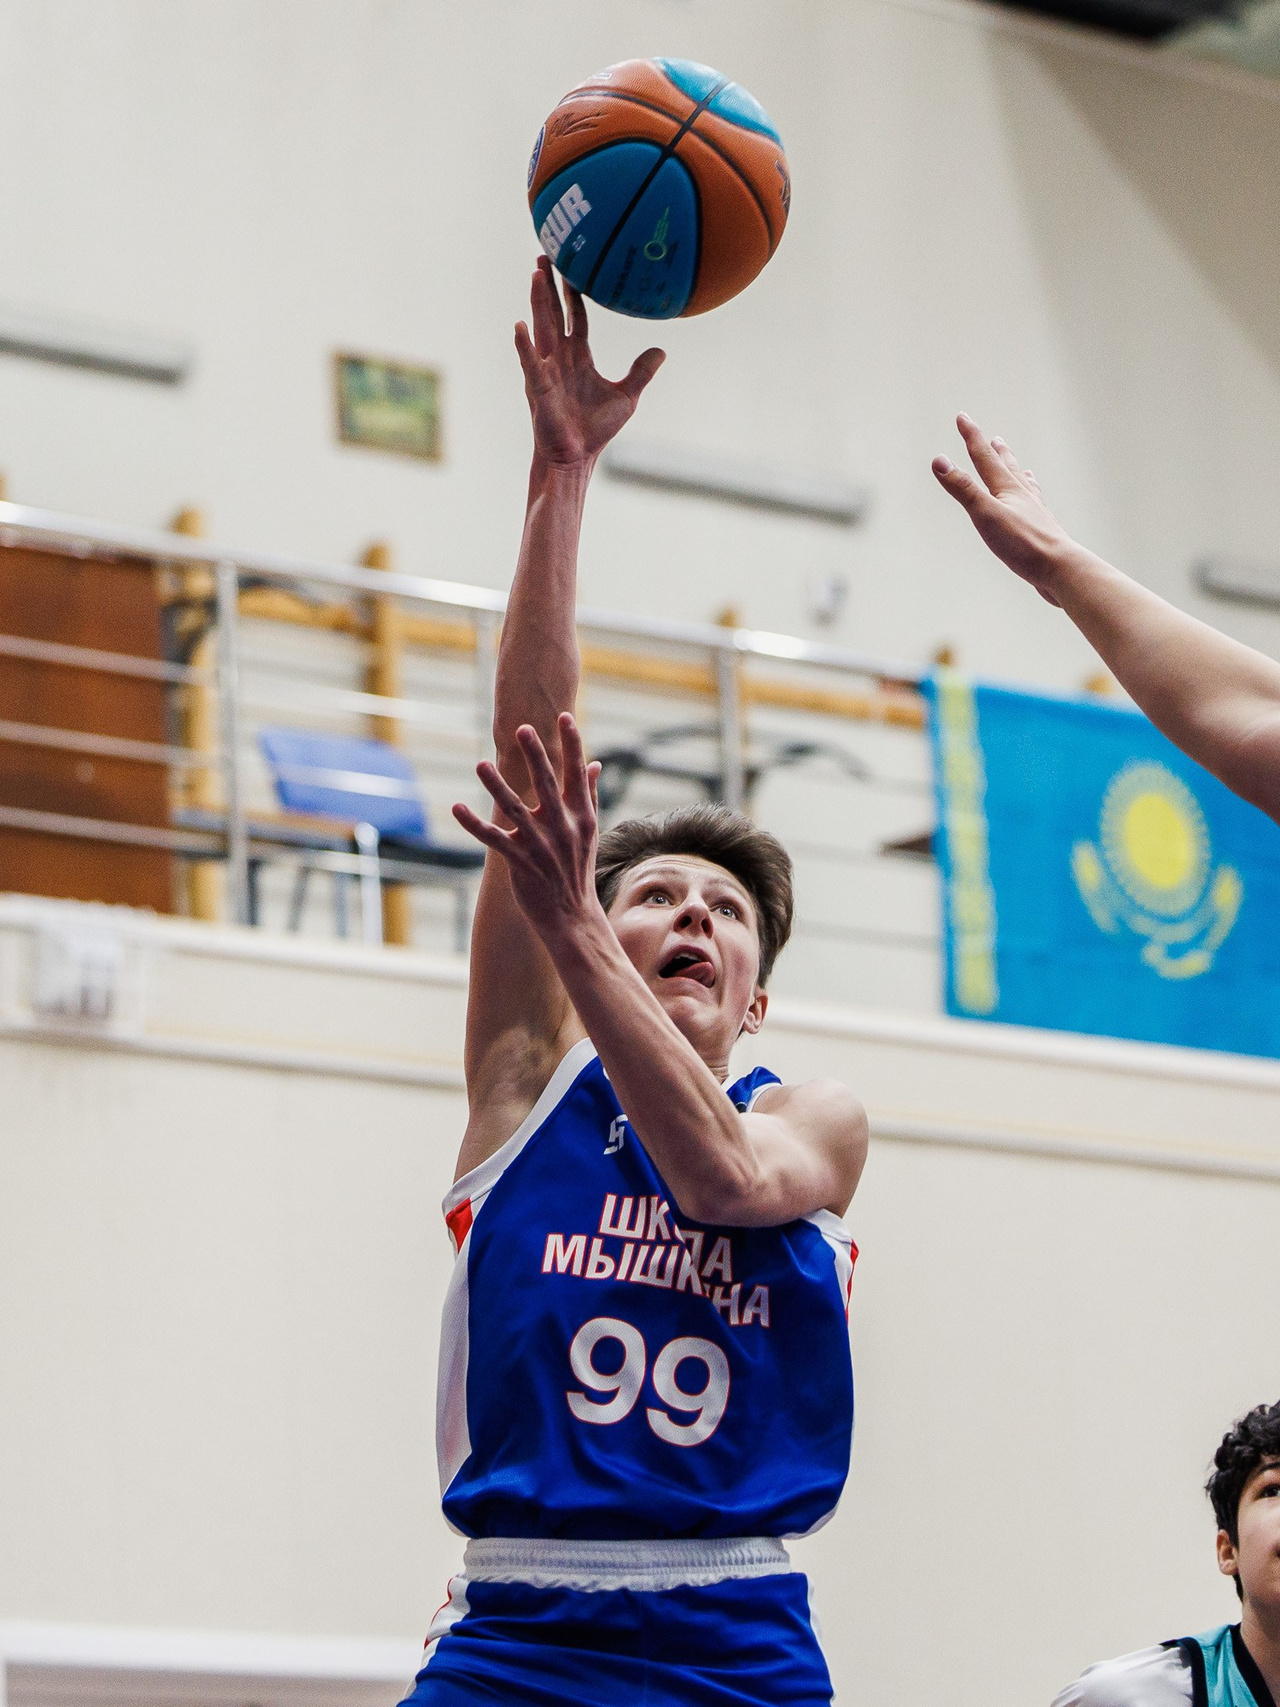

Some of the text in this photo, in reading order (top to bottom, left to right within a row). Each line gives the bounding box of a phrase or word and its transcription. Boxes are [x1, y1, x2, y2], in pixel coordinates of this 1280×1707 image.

[541, 1233, 771, 1328] МЫШКНА
[599, 1193, 734, 1283] ШКЛА
[566, 1317, 730, 1447] 99
